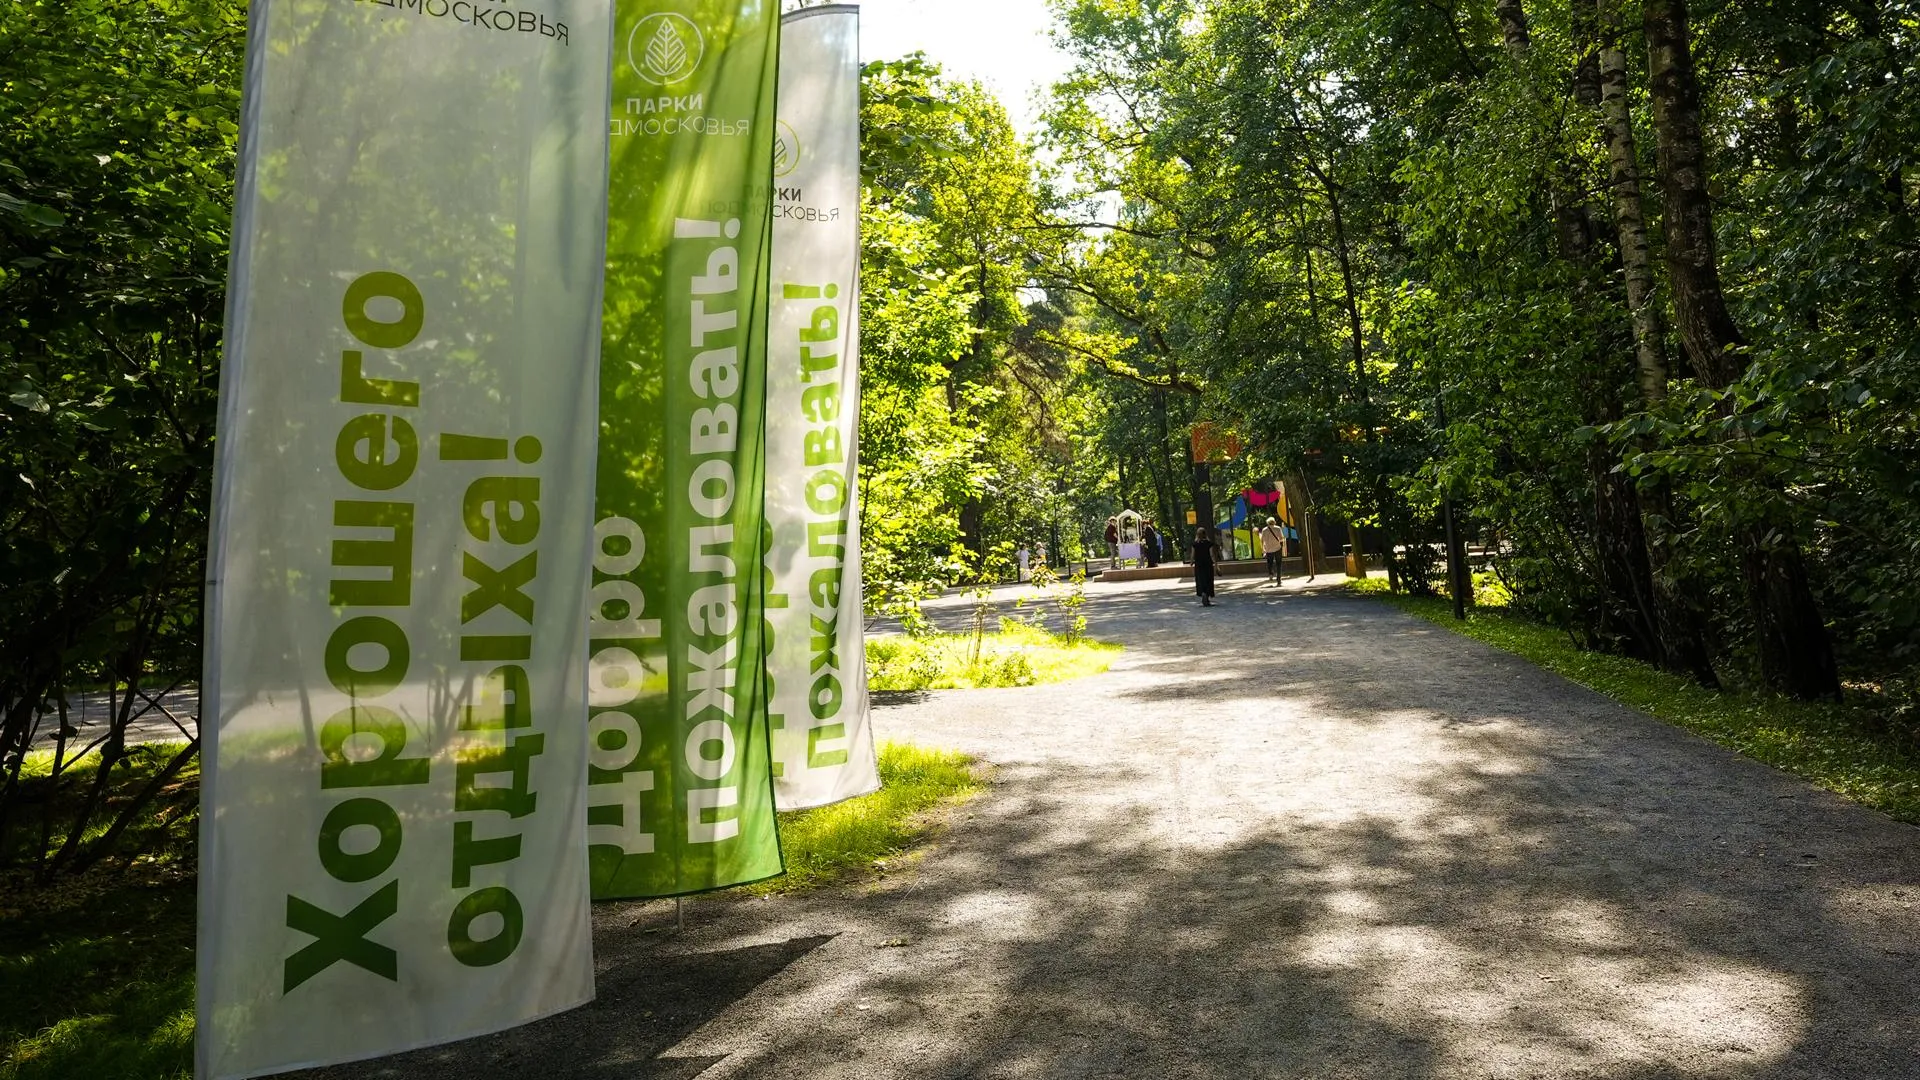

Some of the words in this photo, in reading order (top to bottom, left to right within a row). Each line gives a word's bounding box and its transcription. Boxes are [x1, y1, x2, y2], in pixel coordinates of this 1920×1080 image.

[354, 0, 568, 46] МОСКОВЬЯ
[609, 115, 750, 137] ДМОСКОВЬЯ
[626, 93, 703, 115] ПАРКИ
[283, 270, 430, 996] Хорошего
[439, 432, 545, 968] отдыха!
[674, 217, 740, 844] пожаловать!
[783, 282, 848, 769] пожаловать!
